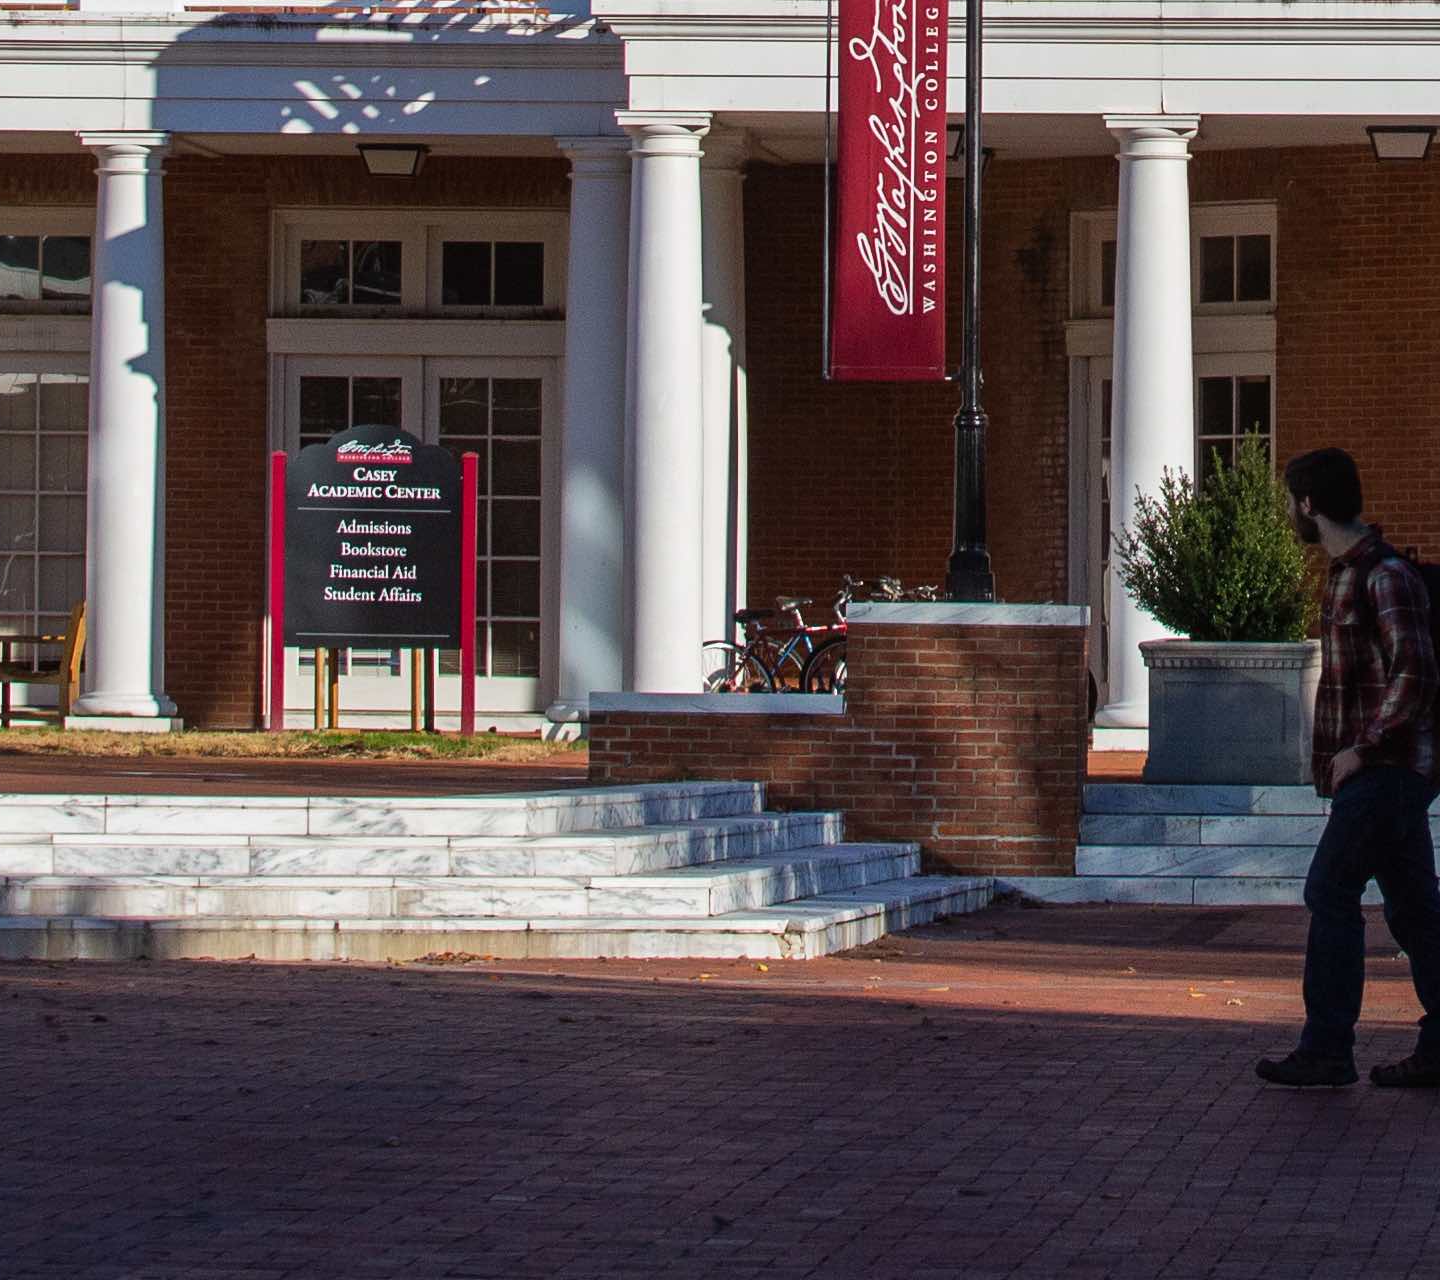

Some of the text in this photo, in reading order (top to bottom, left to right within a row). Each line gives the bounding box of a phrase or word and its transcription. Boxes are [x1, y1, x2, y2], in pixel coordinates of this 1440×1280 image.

[923, 131, 938, 313] WASHINGTON
[353, 467, 397, 482] CASEY
[307, 483, 441, 499] ACADEMIC CENTER
[336, 519, 412, 535] Admissions
[341, 541, 407, 557] Bookstore
[329, 564, 417, 580] Financial Aid
[324, 586, 422, 602] Student Affairs
